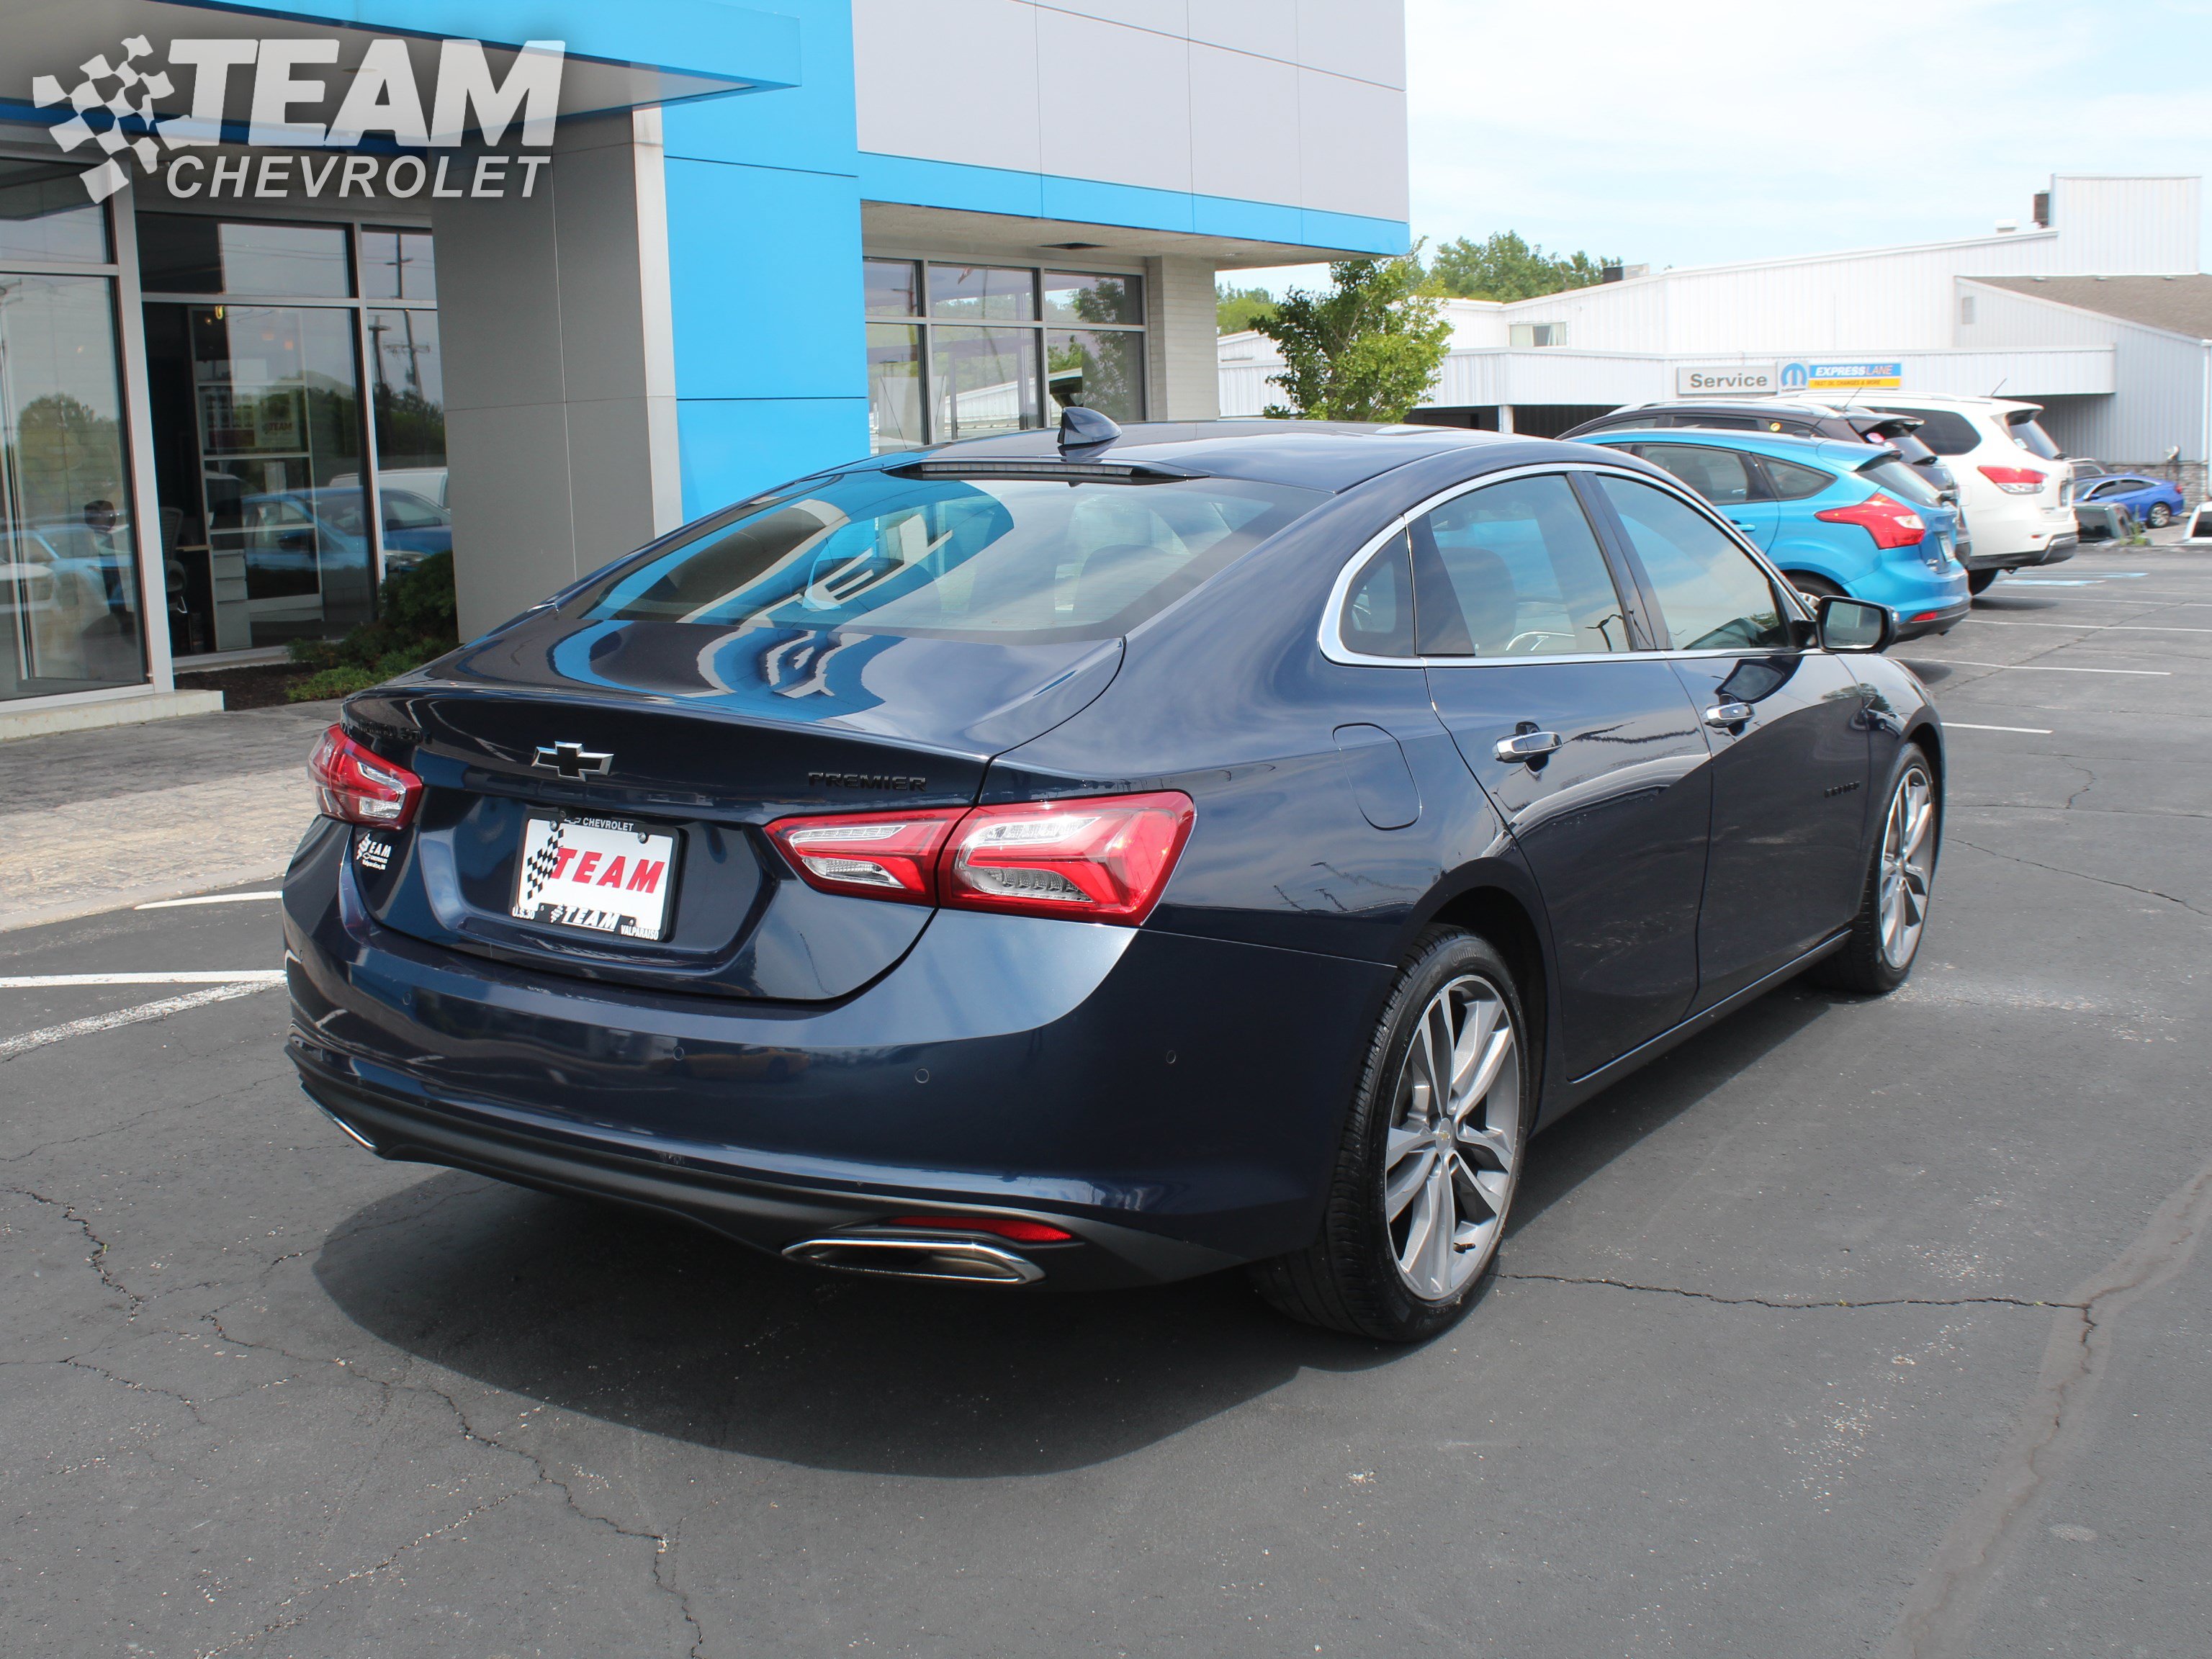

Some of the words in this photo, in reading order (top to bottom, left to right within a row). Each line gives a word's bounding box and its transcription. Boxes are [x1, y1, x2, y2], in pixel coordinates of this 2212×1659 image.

[1690, 372, 1768, 389] Service
[808, 772, 927, 791] PREMIER
[583, 817, 634, 832] CHEVROLET
[363, 840, 392, 858] TEAM
[550, 847, 666, 894] TEAM
[562, 905, 622, 930] TEAM
[621, 924, 659, 941] VALPARAISO
